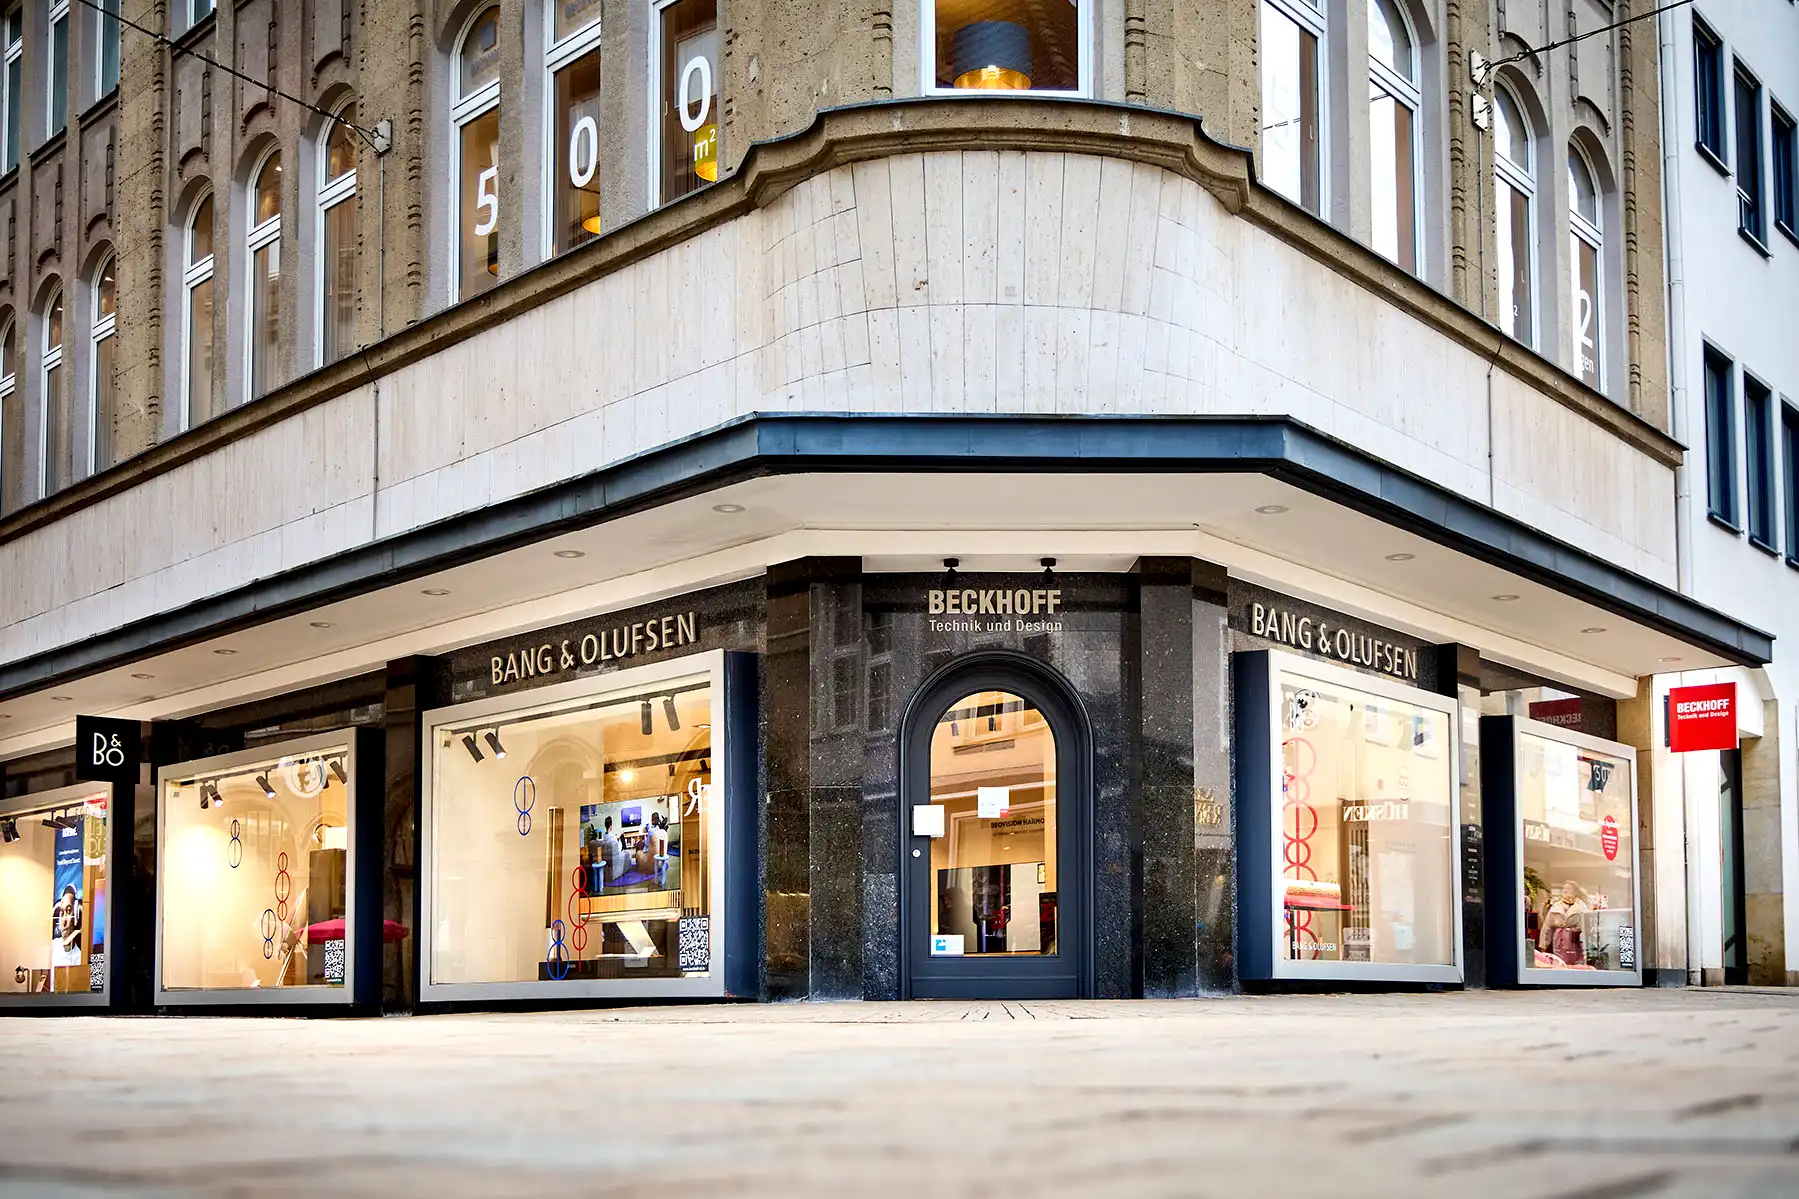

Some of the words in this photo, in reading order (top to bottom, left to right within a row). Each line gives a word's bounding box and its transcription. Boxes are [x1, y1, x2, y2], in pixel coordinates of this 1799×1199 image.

[928, 589, 1062, 615] BECKHOFF
[929, 619, 982, 632] Technik
[986, 619, 1012, 632] und
[1015, 619, 1063, 634] Design
[491, 643, 553, 686] BANG
[559, 640, 575, 670] &
[580, 611, 698, 665] OLUFSEN
[1252, 603, 1313, 647] BANG
[1317, 623, 1332, 654] &
[1336, 628, 1418, 680] OLUFSEN
[1676, 698, 1730, 714] BECKHOFF
[1676, 713, 1698, 721] Technik
[1709, 710, 1730, 719] Design
[93, 732, 125, 767] B&O
